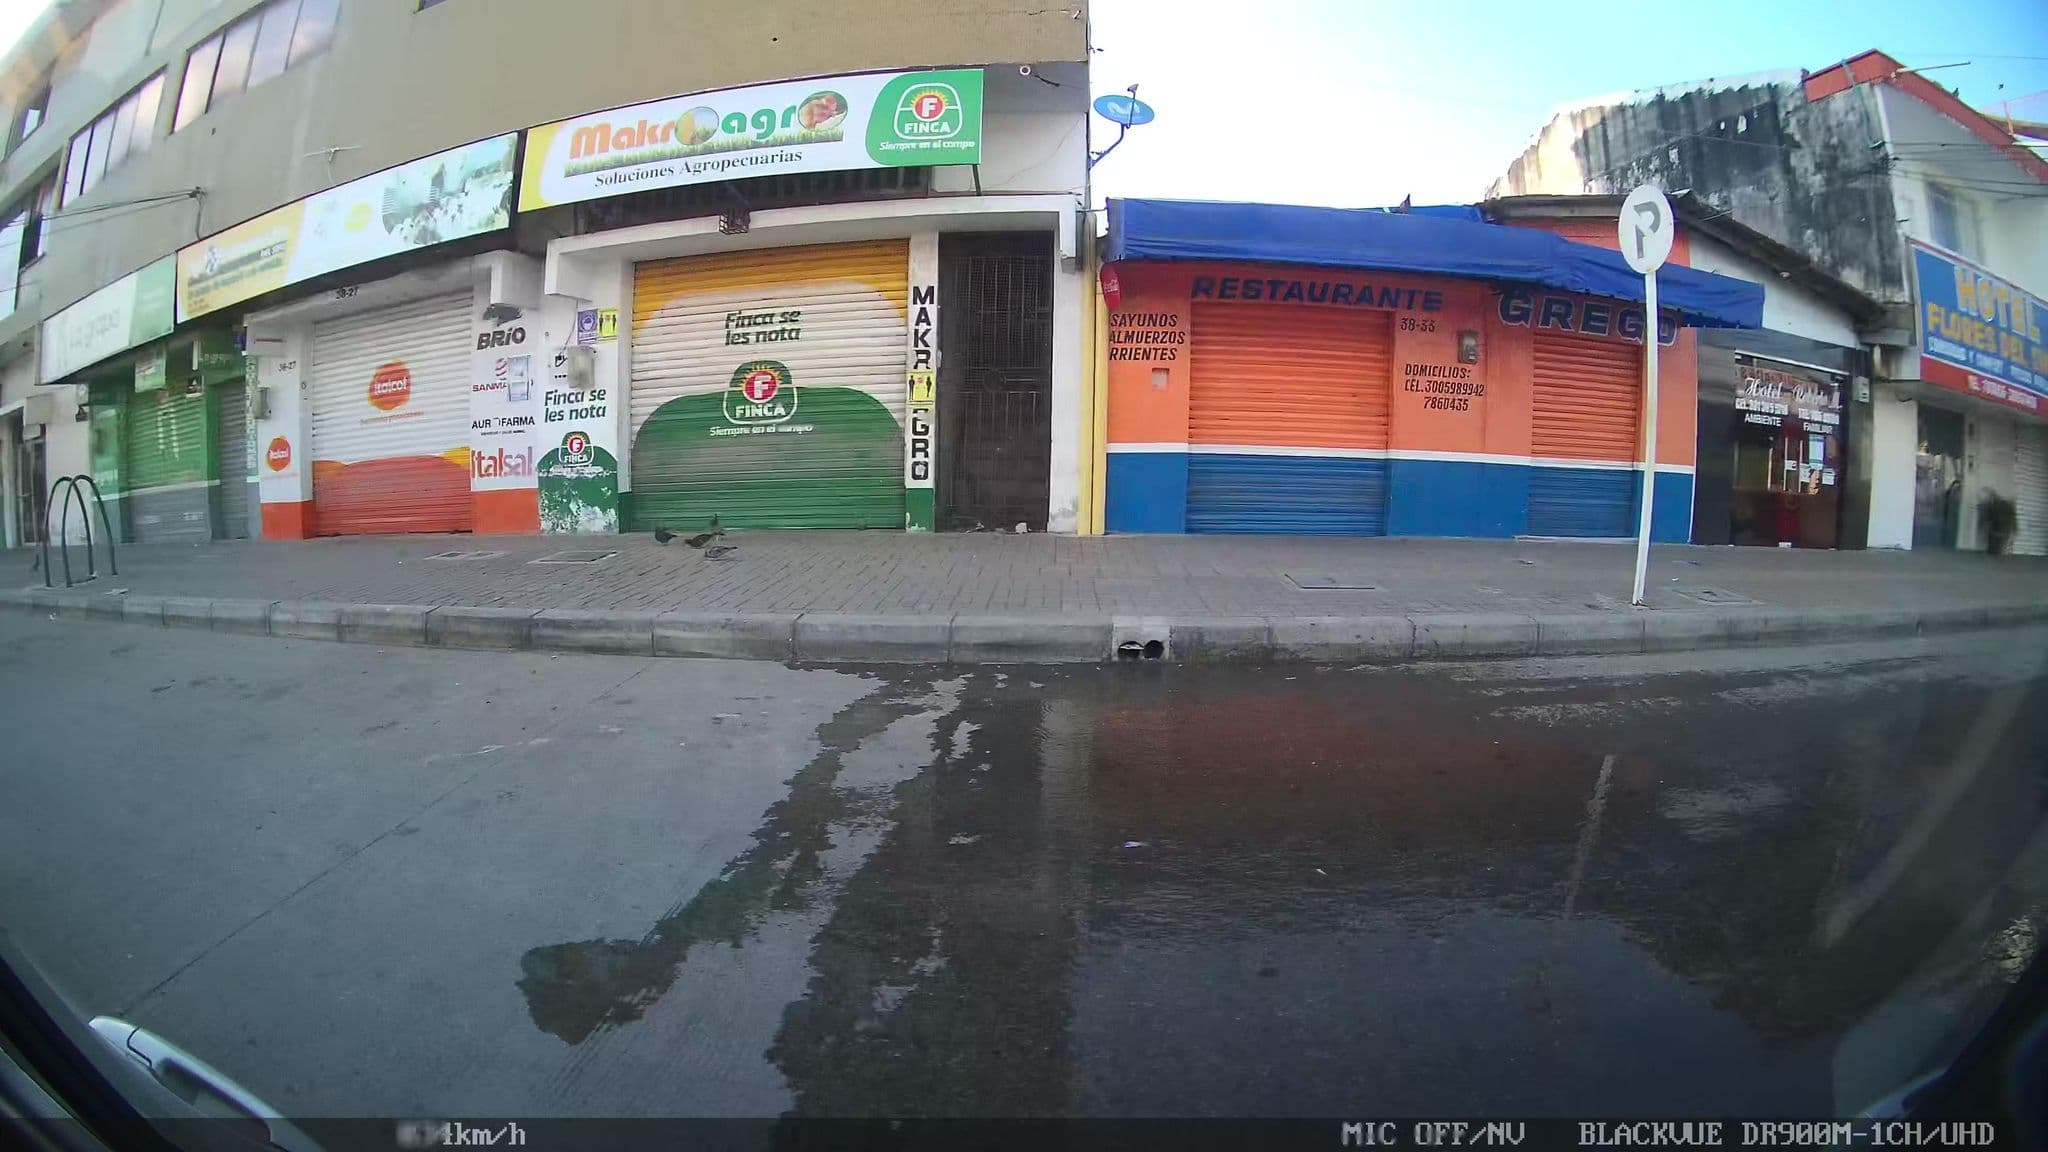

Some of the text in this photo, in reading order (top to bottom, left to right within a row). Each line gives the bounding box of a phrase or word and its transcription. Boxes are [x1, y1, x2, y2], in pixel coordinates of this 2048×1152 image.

[904, 122, 951, 134] FINCA
[880, 142, 917, 151] Siempre
[932, 140, 940, 148] el
[943, 140, 975, 149] campo
[594, 149, 803, 188] Soluciones Agropecuarias
[1191, 275, 1443, 311] RESTAURANTE
[1954, 265, 2041, 344] HOTEL
[725, 311, 801, 329] Finca se
[1400, 317, 1436, 333] 38-33
[1927, 303, 1996, 353] FLORES
[725, 328, 801, 345] les nota
[1109, 330, 1186, 344] ALMUERZOS
[1405, 363, 1471, 378] DOMICILIOS:
[544, 389, 606, 406] Finca se
[544, 405, 606, 423] les nota
[735, 404, 786, 418] FINCA
[710, 426, 751, 437] Siempre
